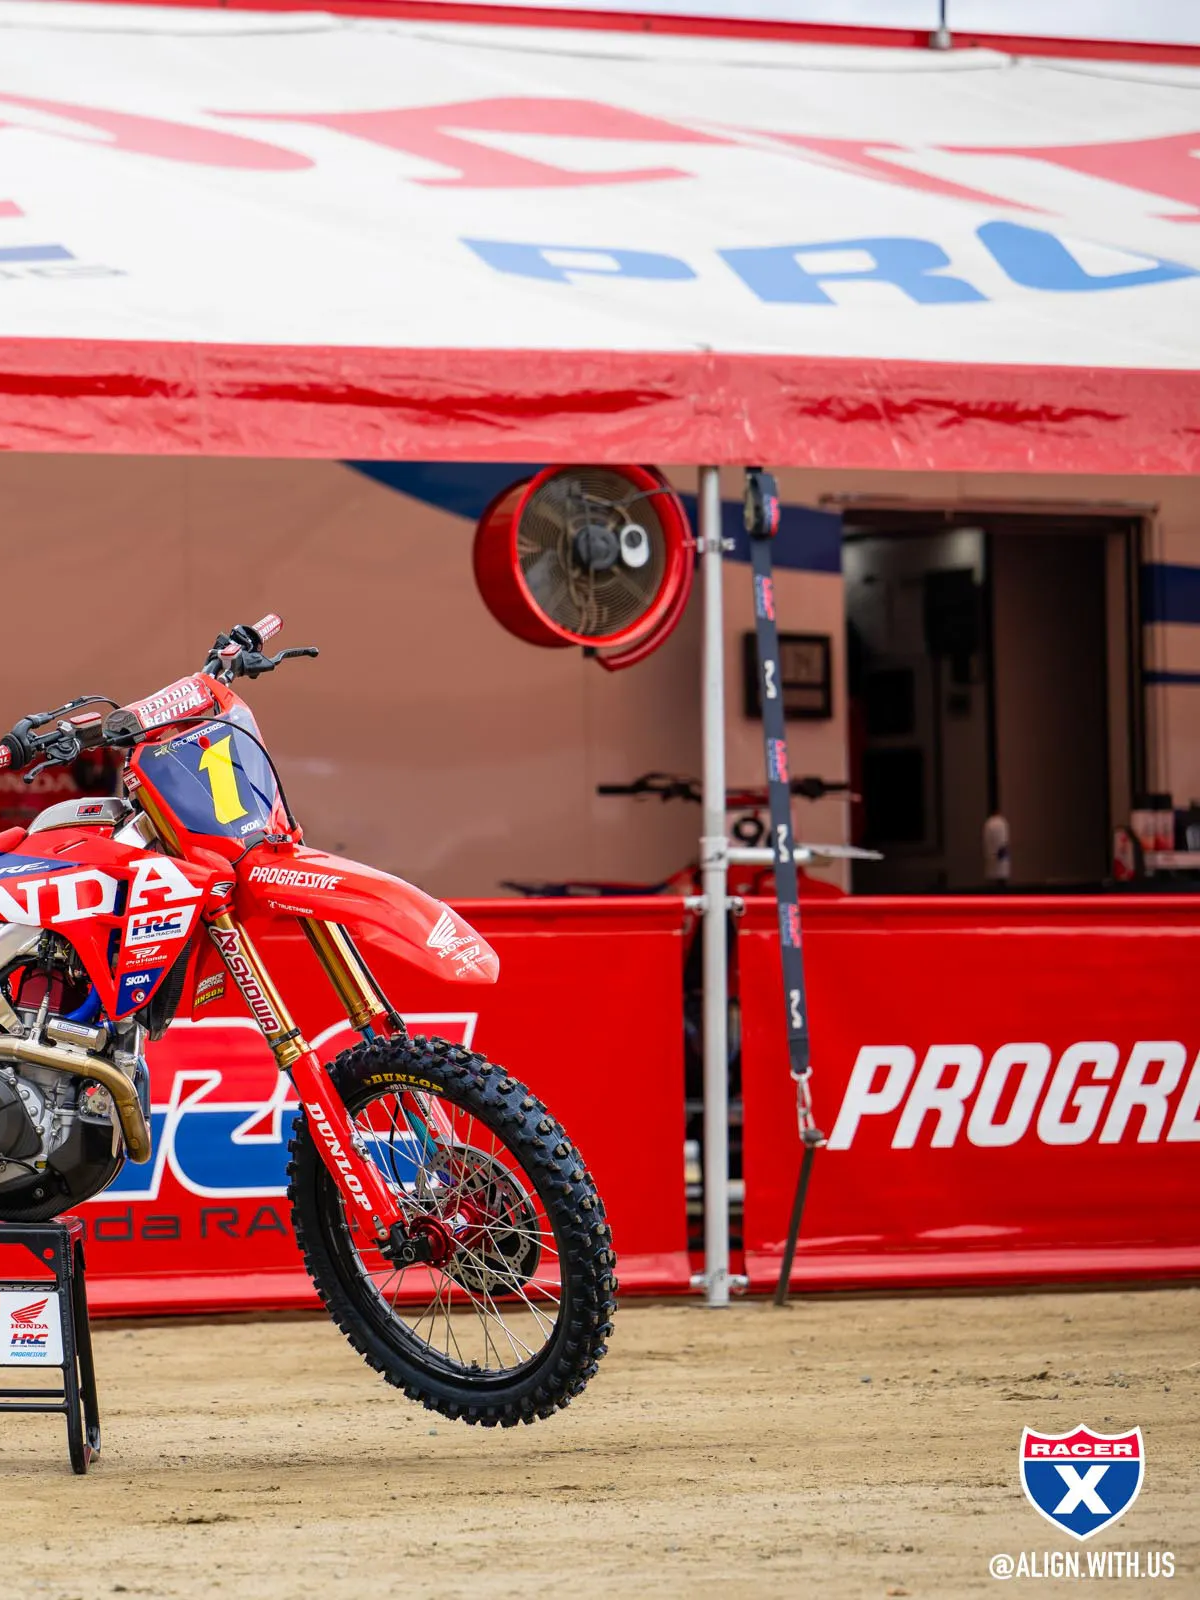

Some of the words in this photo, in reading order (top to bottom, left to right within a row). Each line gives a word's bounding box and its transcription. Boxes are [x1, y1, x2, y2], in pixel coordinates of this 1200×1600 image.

[138, 680, 199, 716] RENTHAL
[198, 735, 249, 825] 1
[248, 865, 343, 890] PROGRESSIVE
[132, 911, 183, 937] HRC
[125, 974, 150, 986] SKDA
[227, 956, 279, 1034] SHOWA
[371, 1072, 444, 1092] DUNLOP
[306, 1102, 373, 1211] DUNLOP
[10, 1333, 49, 1344] HRC
